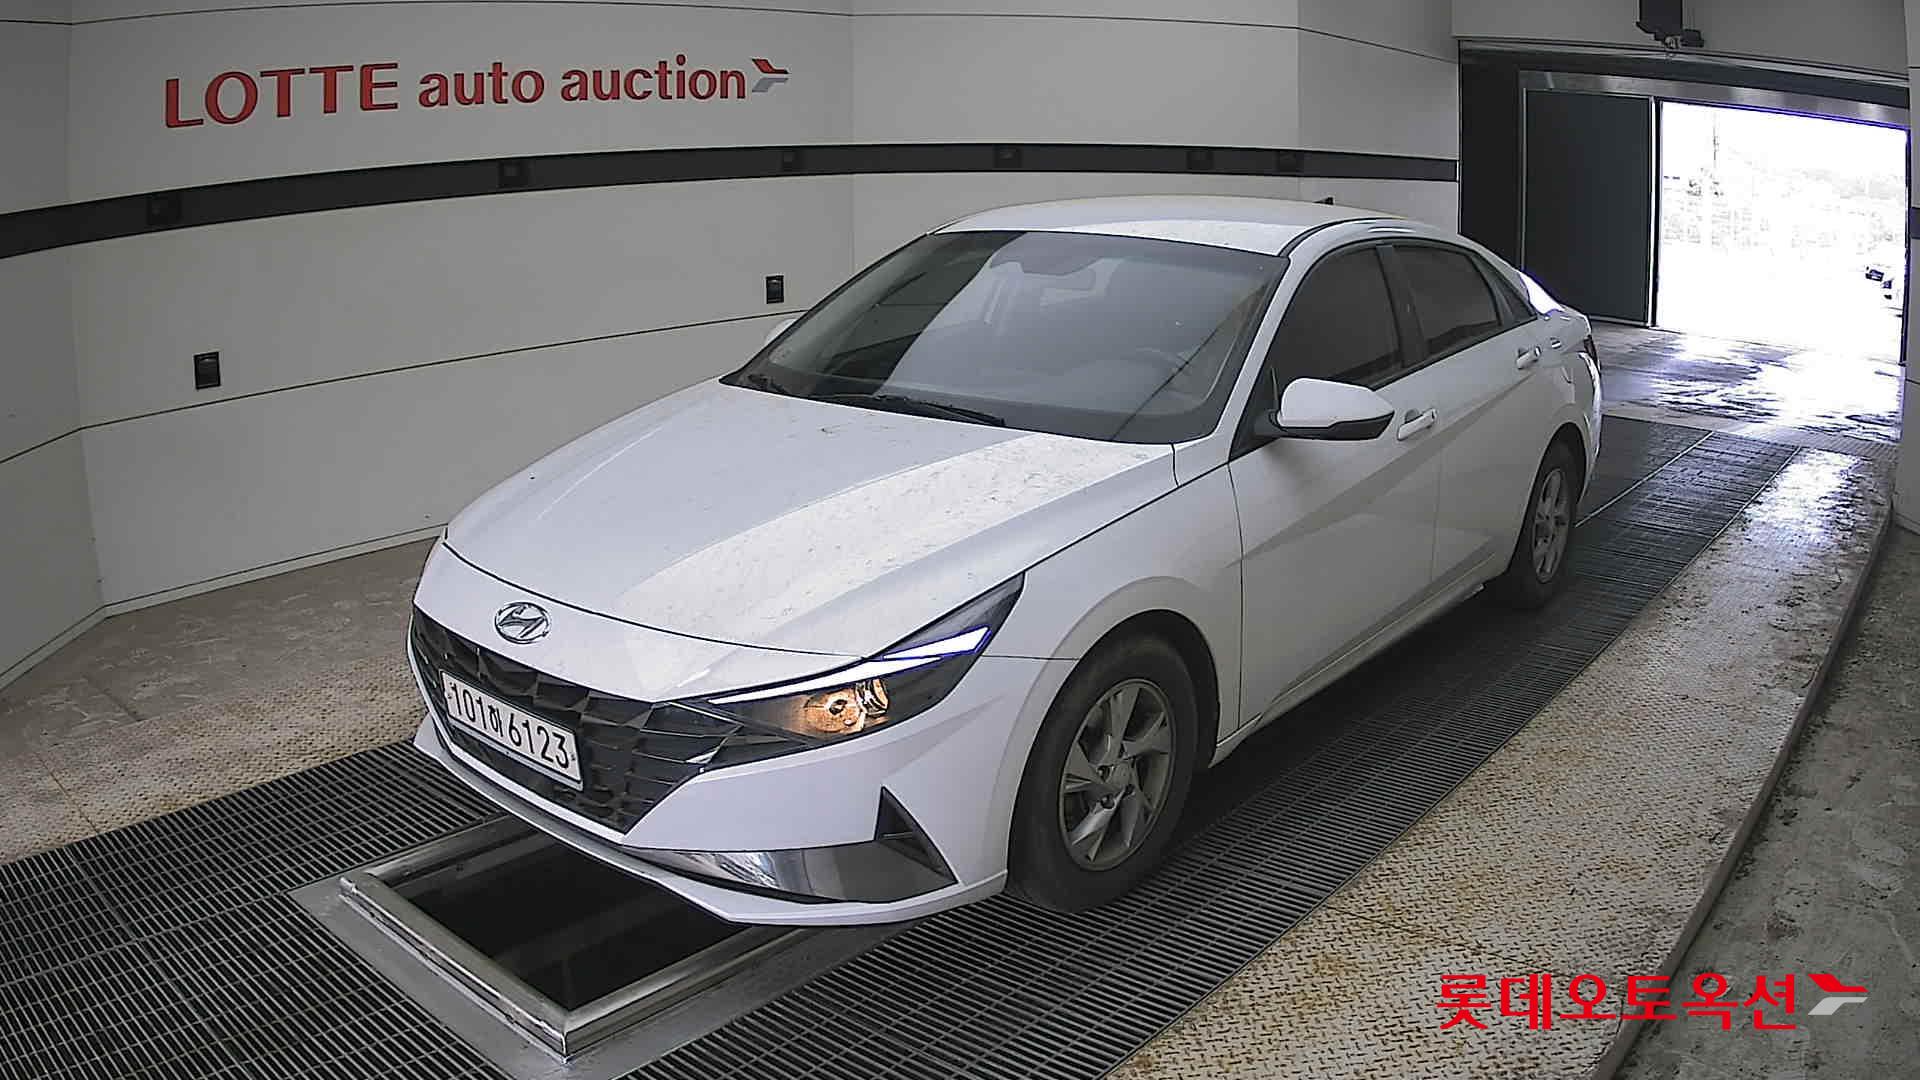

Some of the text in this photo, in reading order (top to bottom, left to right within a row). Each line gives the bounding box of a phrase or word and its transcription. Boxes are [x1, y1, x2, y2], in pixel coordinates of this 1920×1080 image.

[164, 54, 747, 128] LOTTE auto auction
